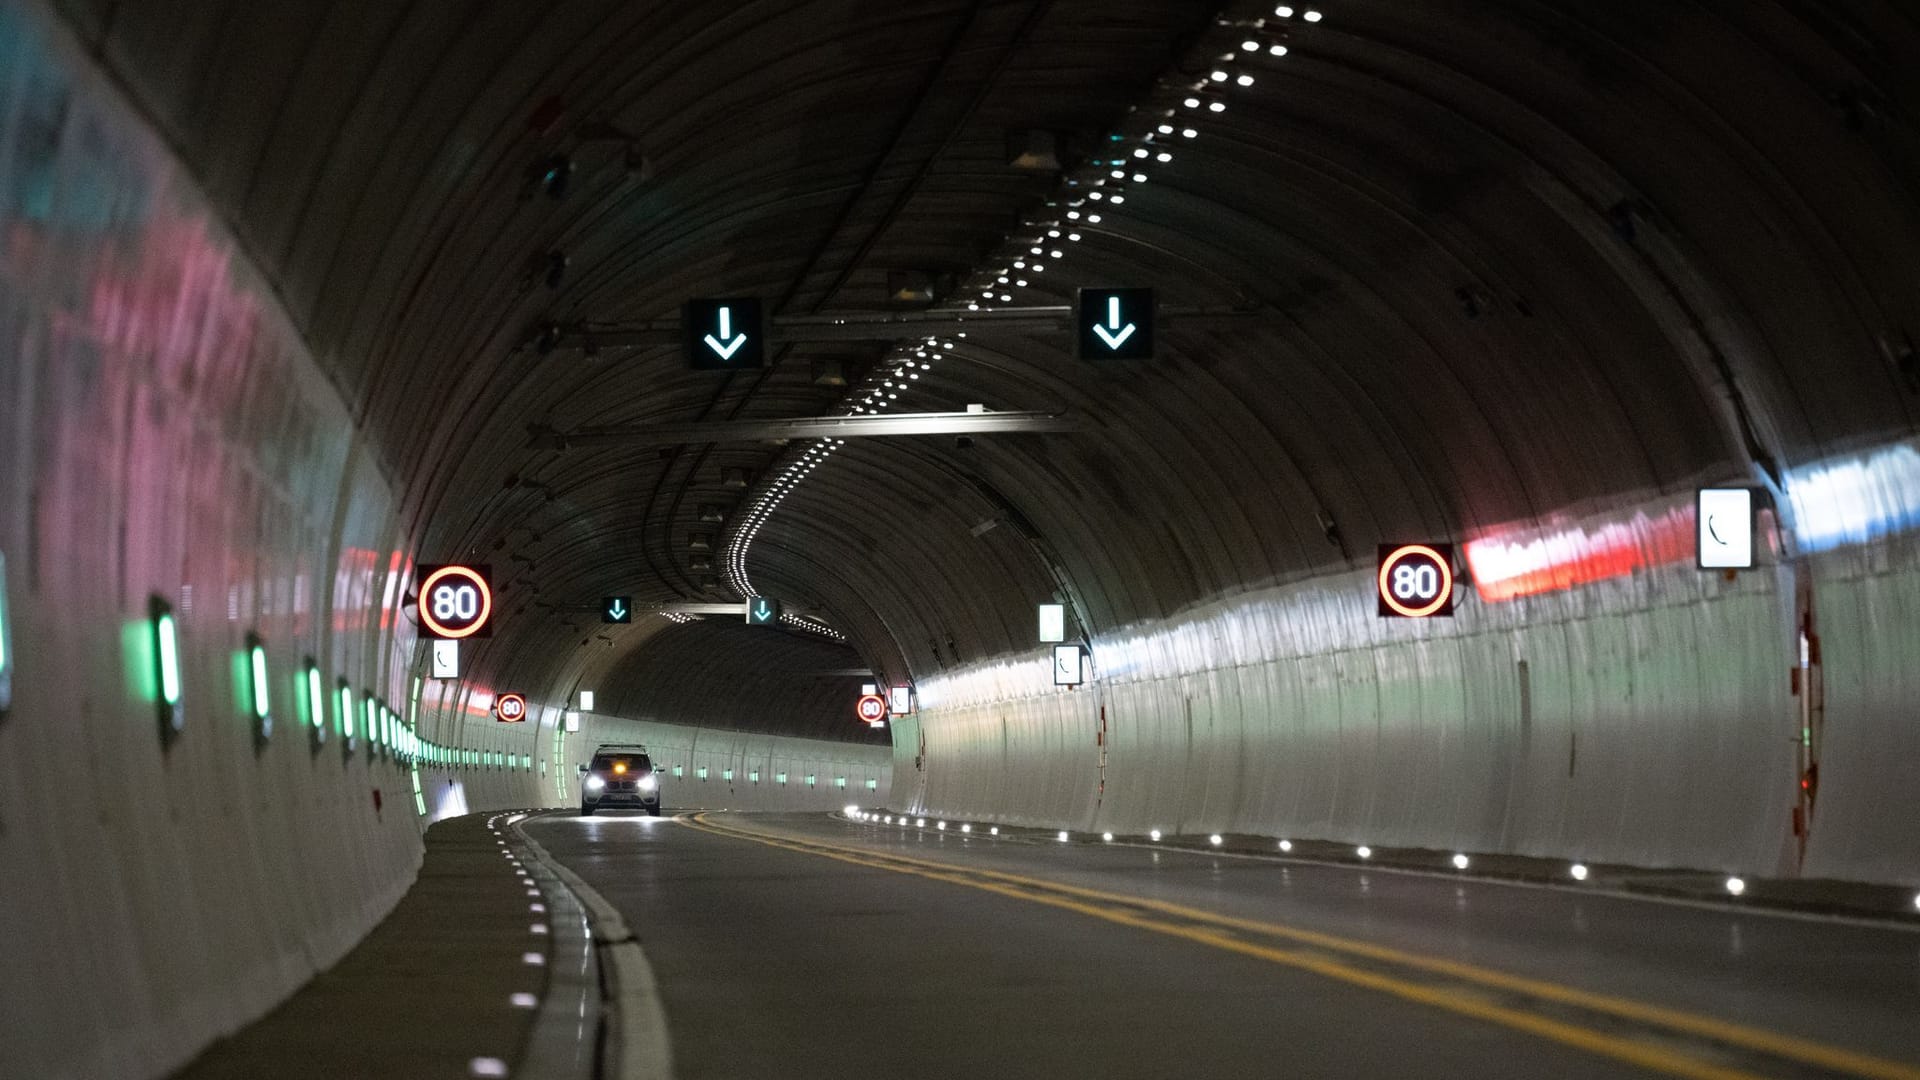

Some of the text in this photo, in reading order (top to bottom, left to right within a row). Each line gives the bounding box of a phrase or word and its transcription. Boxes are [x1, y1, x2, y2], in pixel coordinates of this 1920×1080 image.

[1394, 565, 1437, 599] 80
[434, 586, 477, 620] 80
[503, 701, 520, 715] 80
[862, 701, 880, 716] 80
